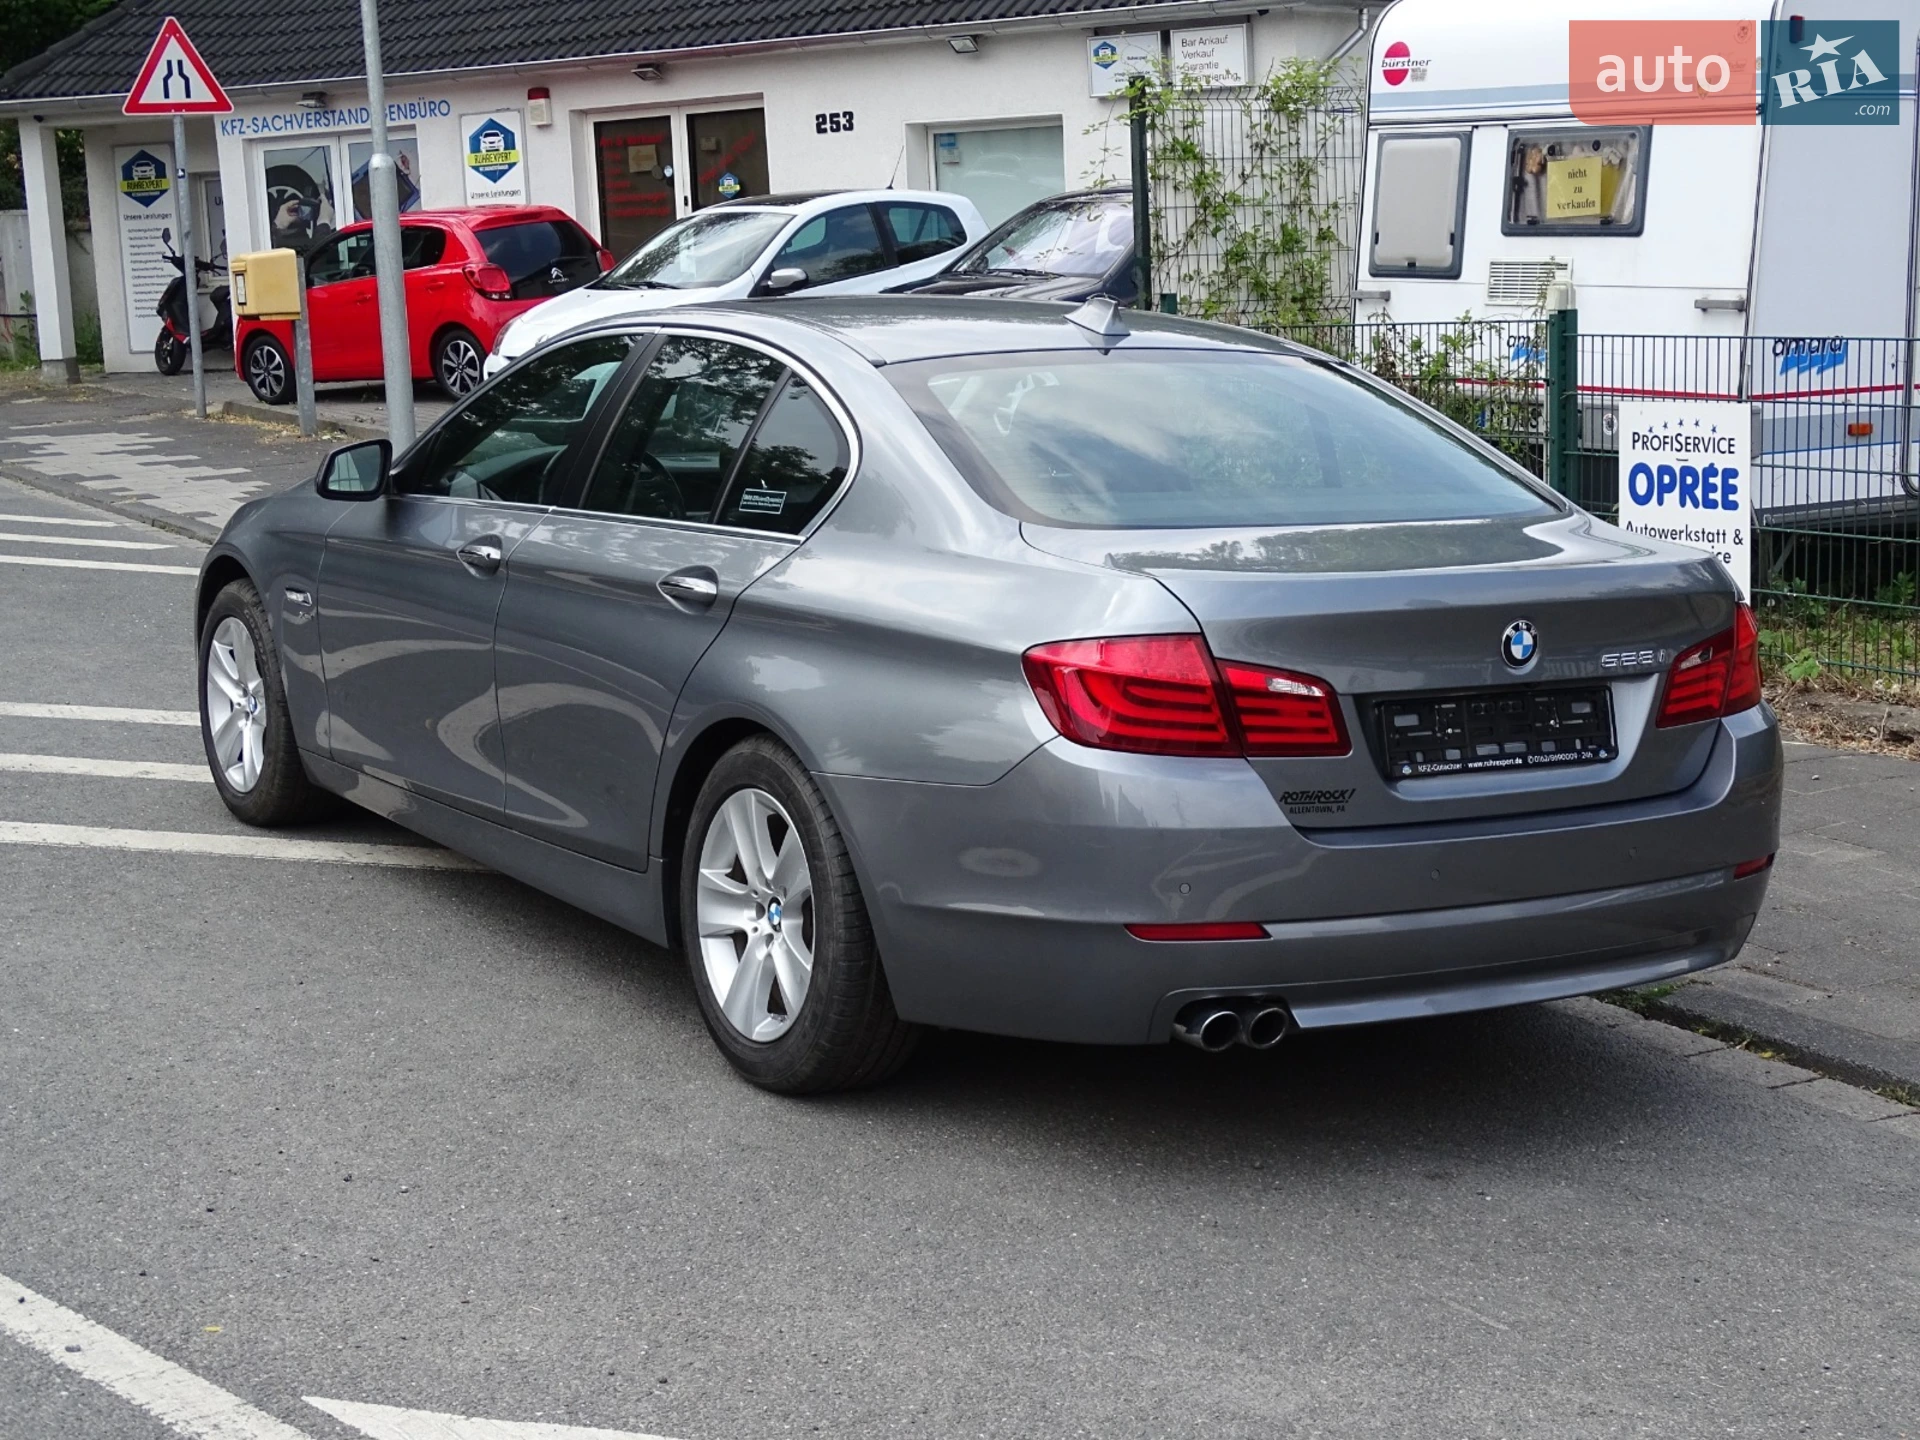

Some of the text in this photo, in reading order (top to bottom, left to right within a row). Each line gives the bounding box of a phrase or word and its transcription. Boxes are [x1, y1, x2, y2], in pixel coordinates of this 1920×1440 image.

[1181, 35, 1228, 47] Bar Ankauf
[1182, 48, 1215, 59] Verkauf
[1381, 58, 1431, 68] bürstner
[815, 111, 854, 134] 253
[1568, 168, 1587, 179] nicht
[1557, 198, 1596, 209] verkaufen
[1628, 462, 1739, 511] OPRÉE
[1626, 521, 1743, 545] Autowerkstatt &
[1280, 788, 1356, 804] ROTHROCK!
